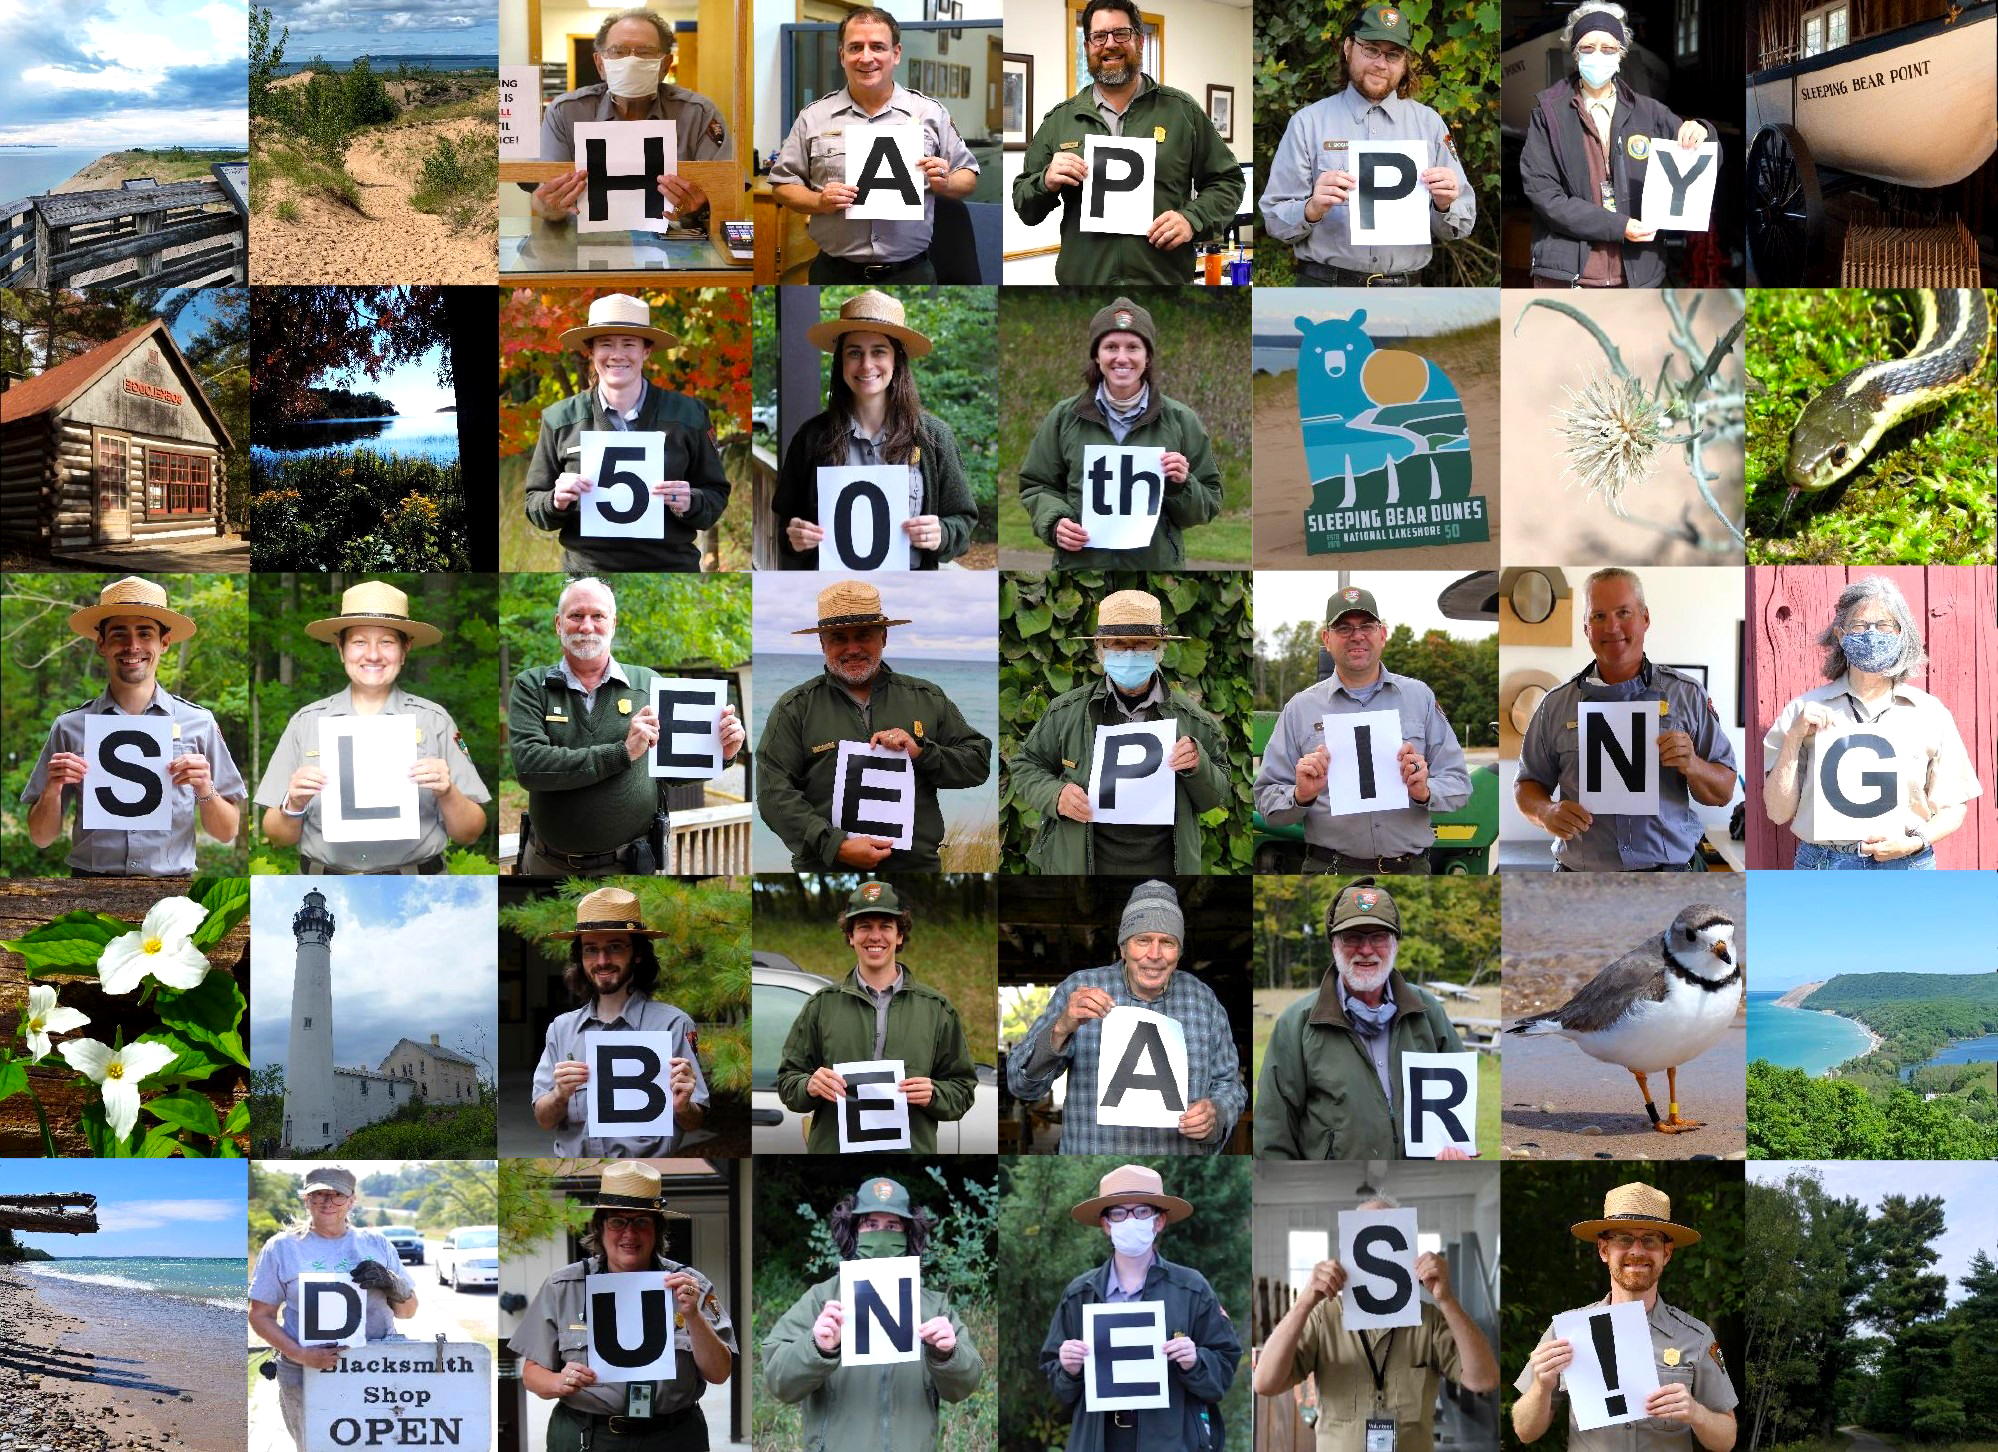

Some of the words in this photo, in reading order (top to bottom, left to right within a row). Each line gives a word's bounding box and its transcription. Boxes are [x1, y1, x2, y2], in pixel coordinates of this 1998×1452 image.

[499, 108, 512, 116] LL
[505, 93, 514, 103] IS
[1801, 81, 1849, 101] SLEEPING
[1852, 73, 1885, 92] BEAR
[1890, 60, 1931, 83] POINT
[499, 136, 519, 144] ICE!
[855, 137, 921, 205] A
[586, 137, 664, 221] H
[1090, 147, 1144, 218] P
[1359, 153, 1417, 229] P
[1657, 150, 1713, 217] Y
[596, 447, 649, 524] 5
[1089, 455, 1160, 515] th
[1308, 510, 1381, 532] SLEEPING
[1386, 505, 1427, 526] BEAR
[1431, 501, 1482, 522] DUNES
[834, 481, 890, 570] 0
[1343, 530, 1387, 543] NATIONAL
[1389, 526, 1441, 540] LAKESHORE
[1444, 524, 1460, 538] 50
[657, 690, 715, 768] E
[1354, 726, 1376, 799] I
[1587, 713, 1646, 792] N
[95, 731, 163, 817] S
[338, 736, 401, 820] L
[841, 754, 906, 838] E
[1099, 733, 1163, 809] P
[1821, 734, 1897, 819] G
[597, 1045, 666, 1123] B
[1100, 1021, 1186, 1111] A
[842, 1071, 901, 1142] E
[1410, 1067, 1471, 1142] R
[1352, 1226, 1412, 1315] S
[305, 1282, 361, 1340] D
[592, 1290, 667, 1368] U
[854, 1278, 913, 1354] N
[1094, 1312, 1160, 1398] E
[1589, 1313, 1628, 1417] !
[329, 1418, 463, 1446] OPEN
[364, 1387, 431, 1408] Shop
